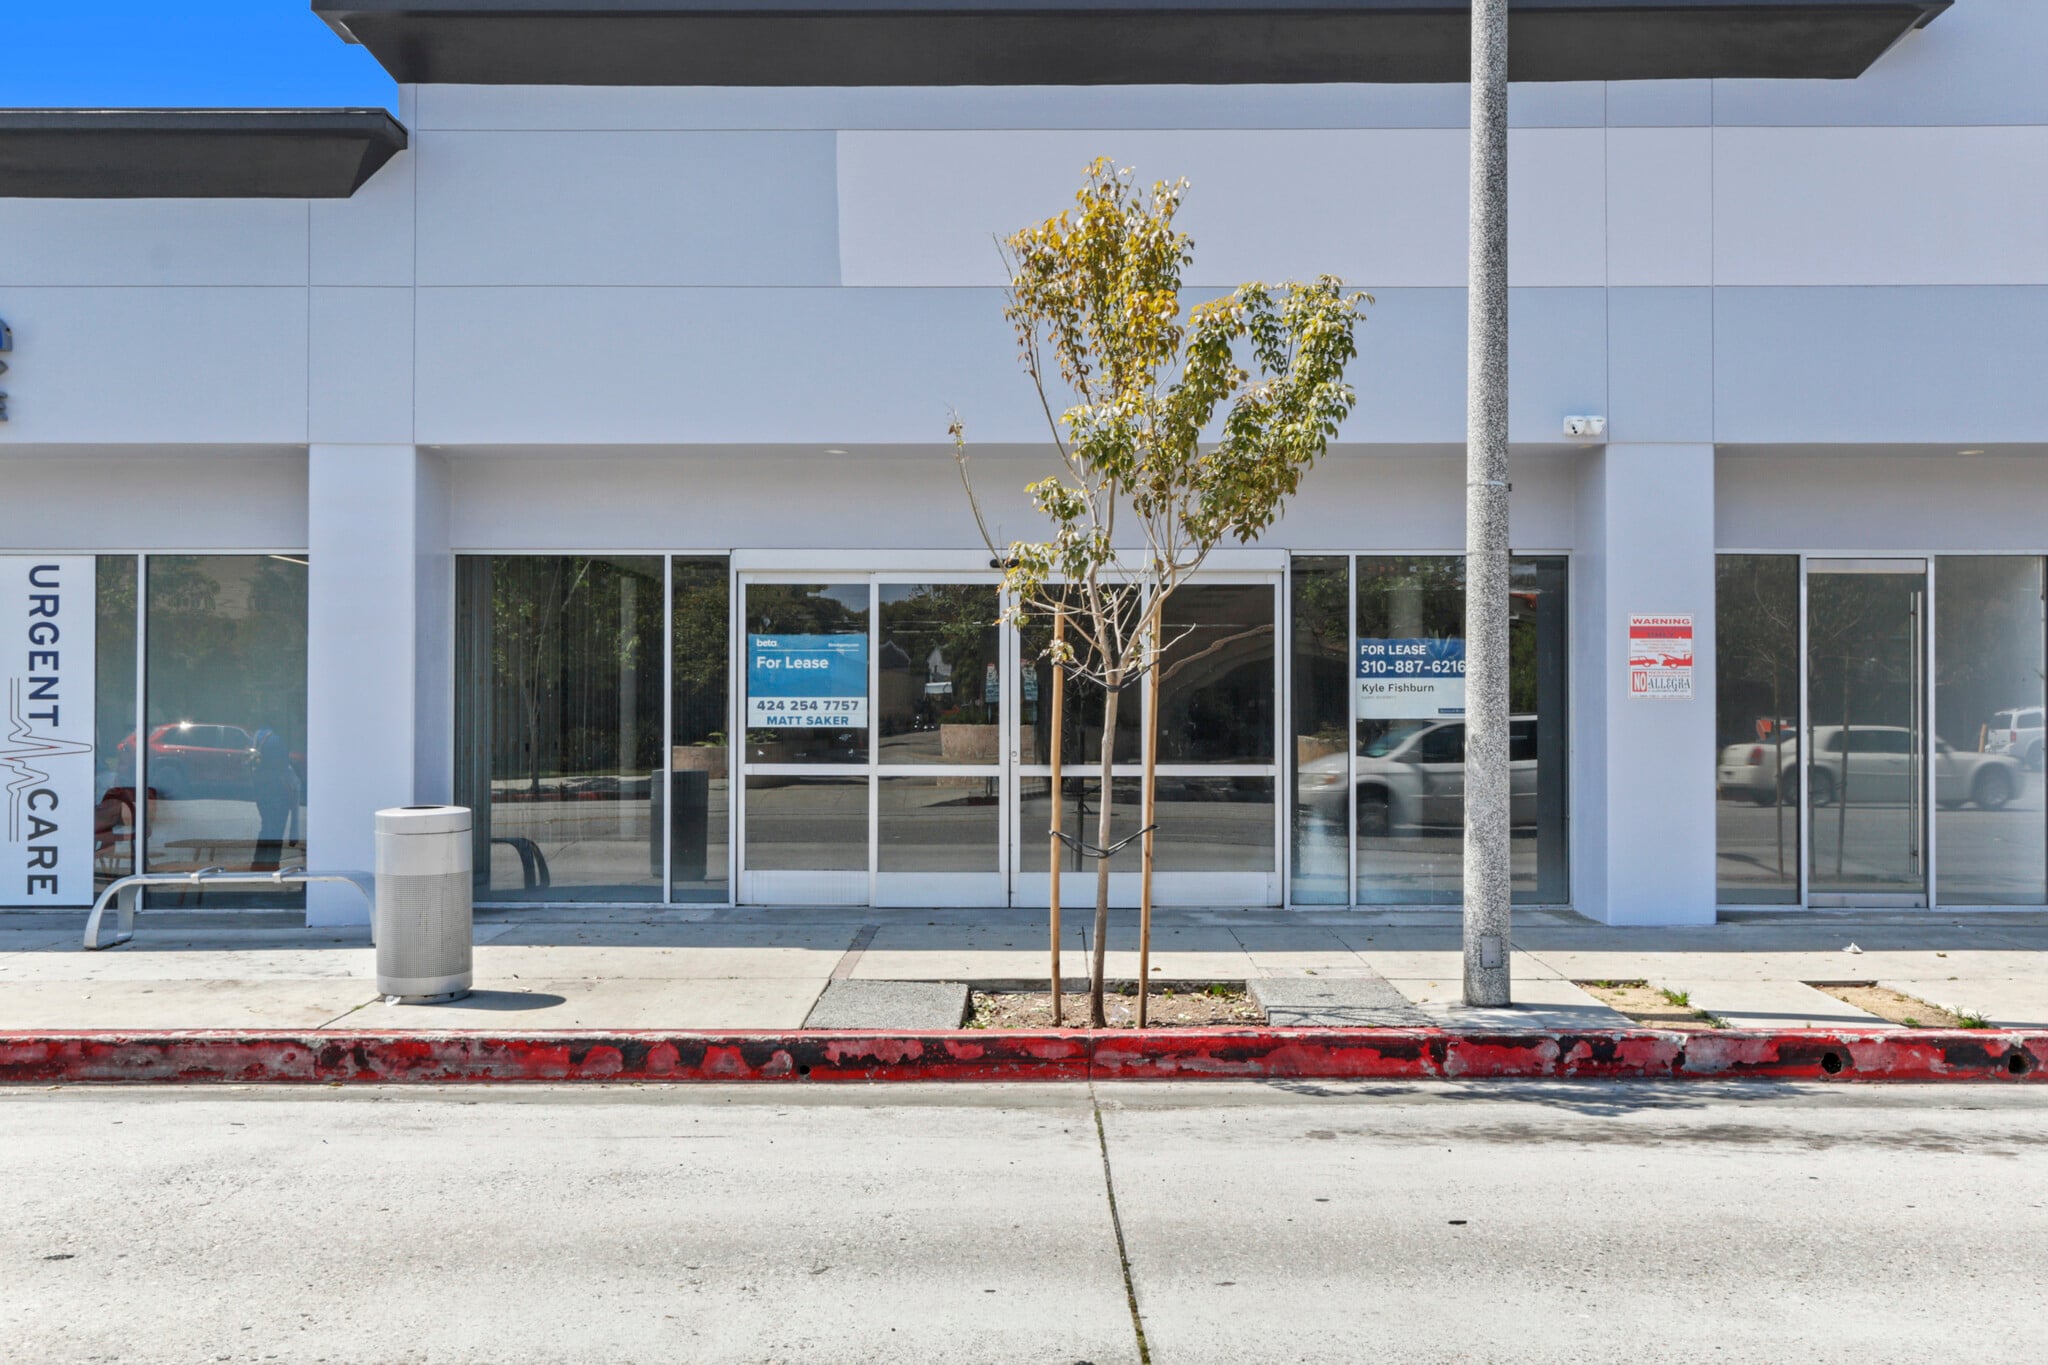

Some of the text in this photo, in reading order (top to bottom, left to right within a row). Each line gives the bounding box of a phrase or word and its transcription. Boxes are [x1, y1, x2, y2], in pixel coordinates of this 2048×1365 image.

[1361, 645, 1427, 655] FOR LEASE
[756, 656, 829, 669] For Lease
[1361, 660, 1466, 673] 310-887-6216
[1634, 673, 1691, 691] NO ALLEGRA
[1362, 683, 1434, 695] Kyle Fishburn
[757, 701, 859, 711] 424 254 7757
[766, 716, 849, 725] MATT SAKER
[27, 565, 60, 895] URGENT CARE
